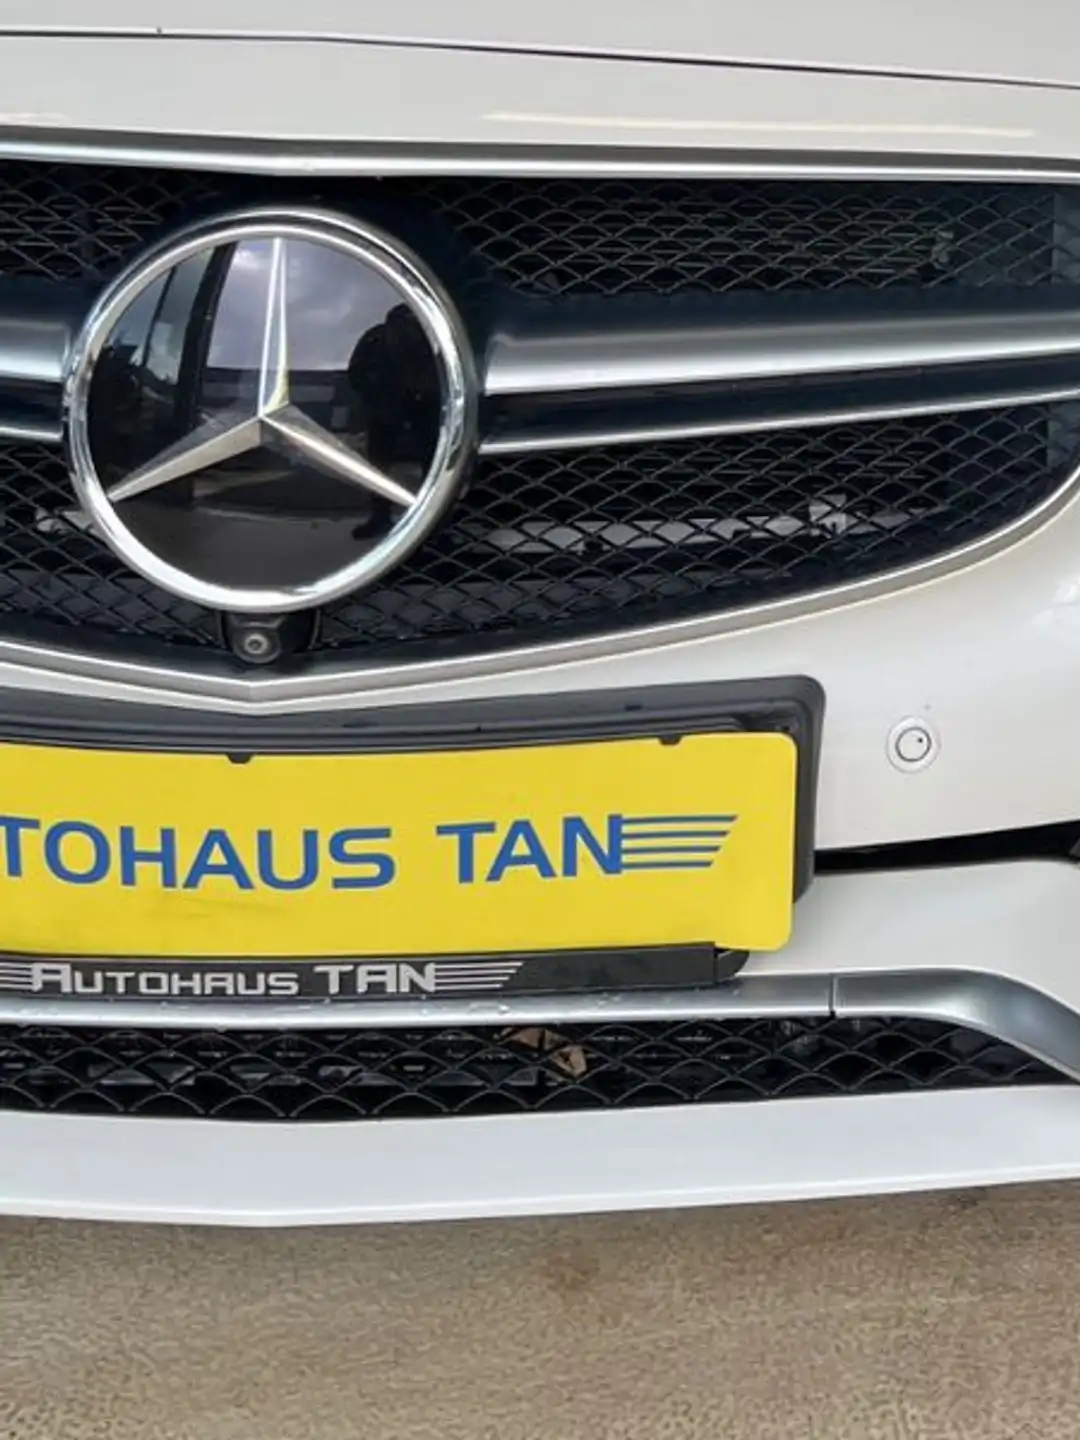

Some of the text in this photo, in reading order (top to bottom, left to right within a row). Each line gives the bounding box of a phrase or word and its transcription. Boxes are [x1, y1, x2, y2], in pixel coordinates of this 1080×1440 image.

[0, 813, 623, 890] TOHAUS TAN
[313, 962, 437, 995] TAN
